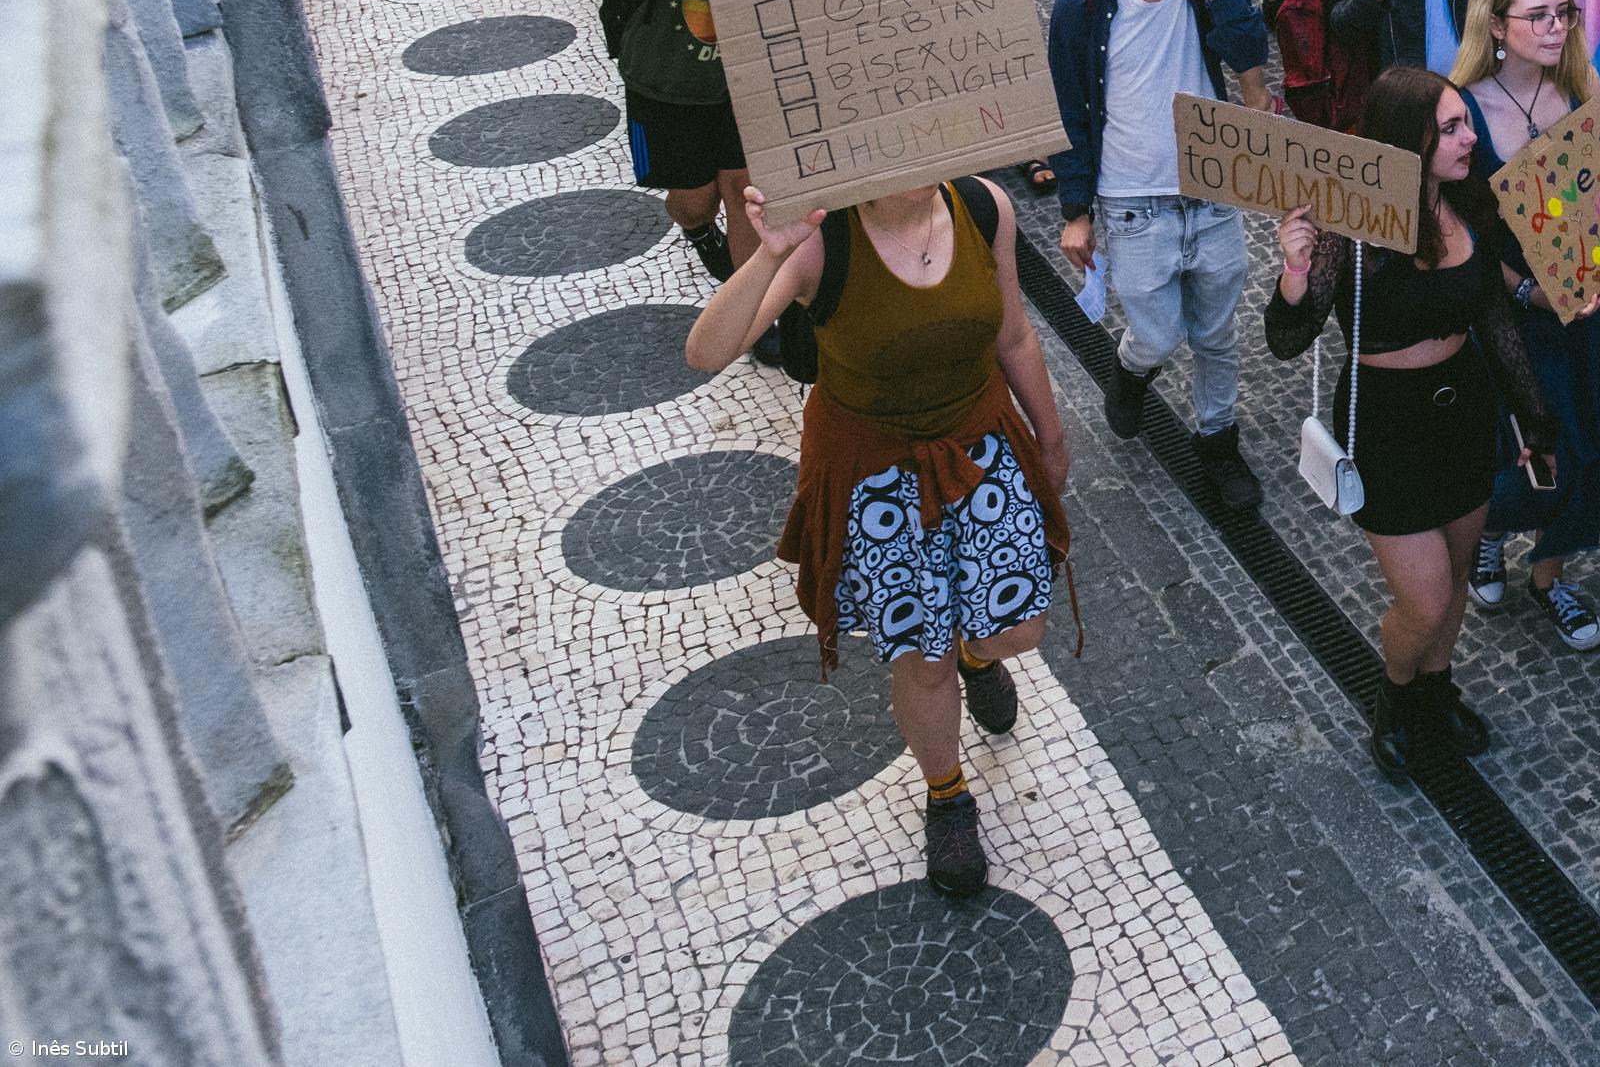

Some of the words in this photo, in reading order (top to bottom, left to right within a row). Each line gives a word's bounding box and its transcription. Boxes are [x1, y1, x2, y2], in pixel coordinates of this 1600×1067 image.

[826, 28, 1031, 91] BISEXUAL
[837, 53, 1036, 125] STRAIGHT
[845, 101, 1005, 169] HUMAN
[1184, 144, 1224, 190] to
[1188, 102, 1271, 159] You
[1284, 137, 1384, 190] need
[1531, 168, 1595, 234] Love
